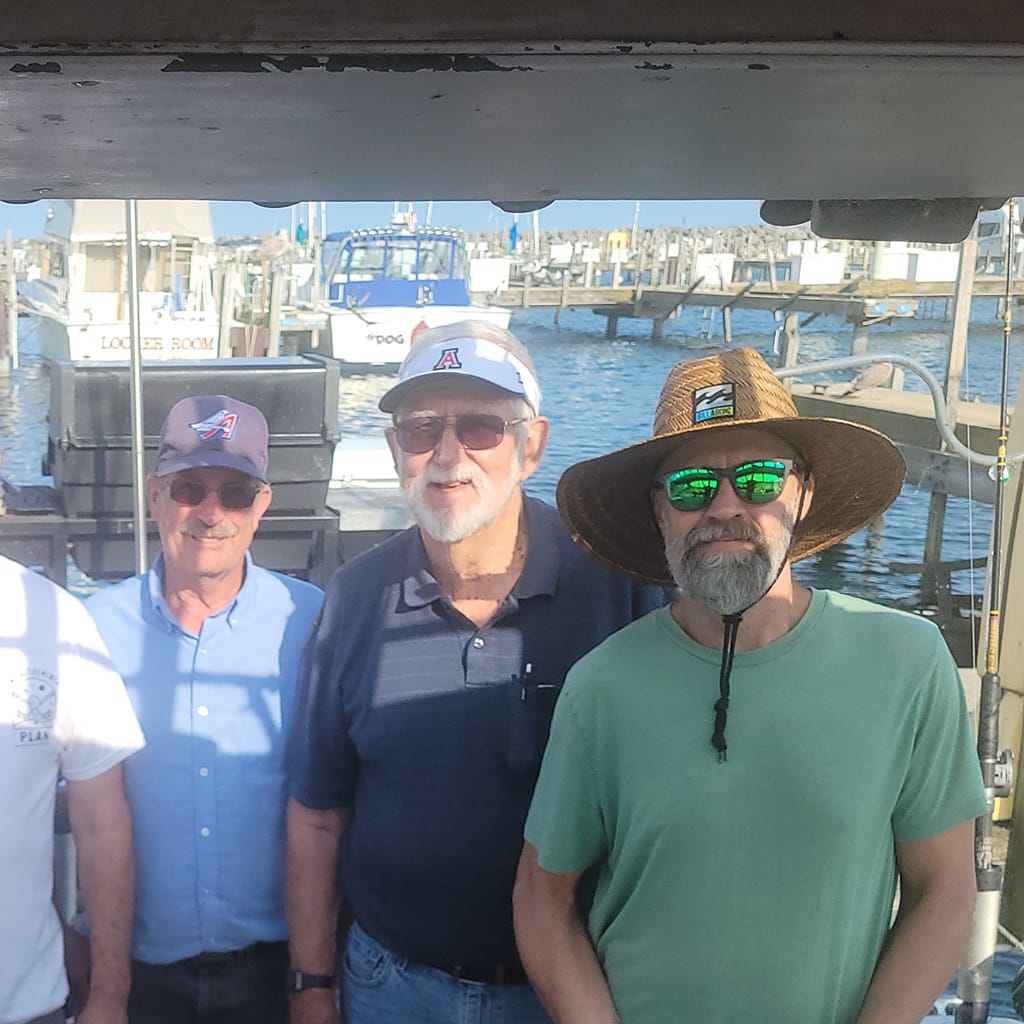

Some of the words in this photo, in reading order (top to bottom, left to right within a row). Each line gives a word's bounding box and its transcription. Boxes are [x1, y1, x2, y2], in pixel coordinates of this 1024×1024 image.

[101, 336, 163, 350] LOCER
[171, 337, 214, 350] ROOM
[433, 347, 462, 371] A
